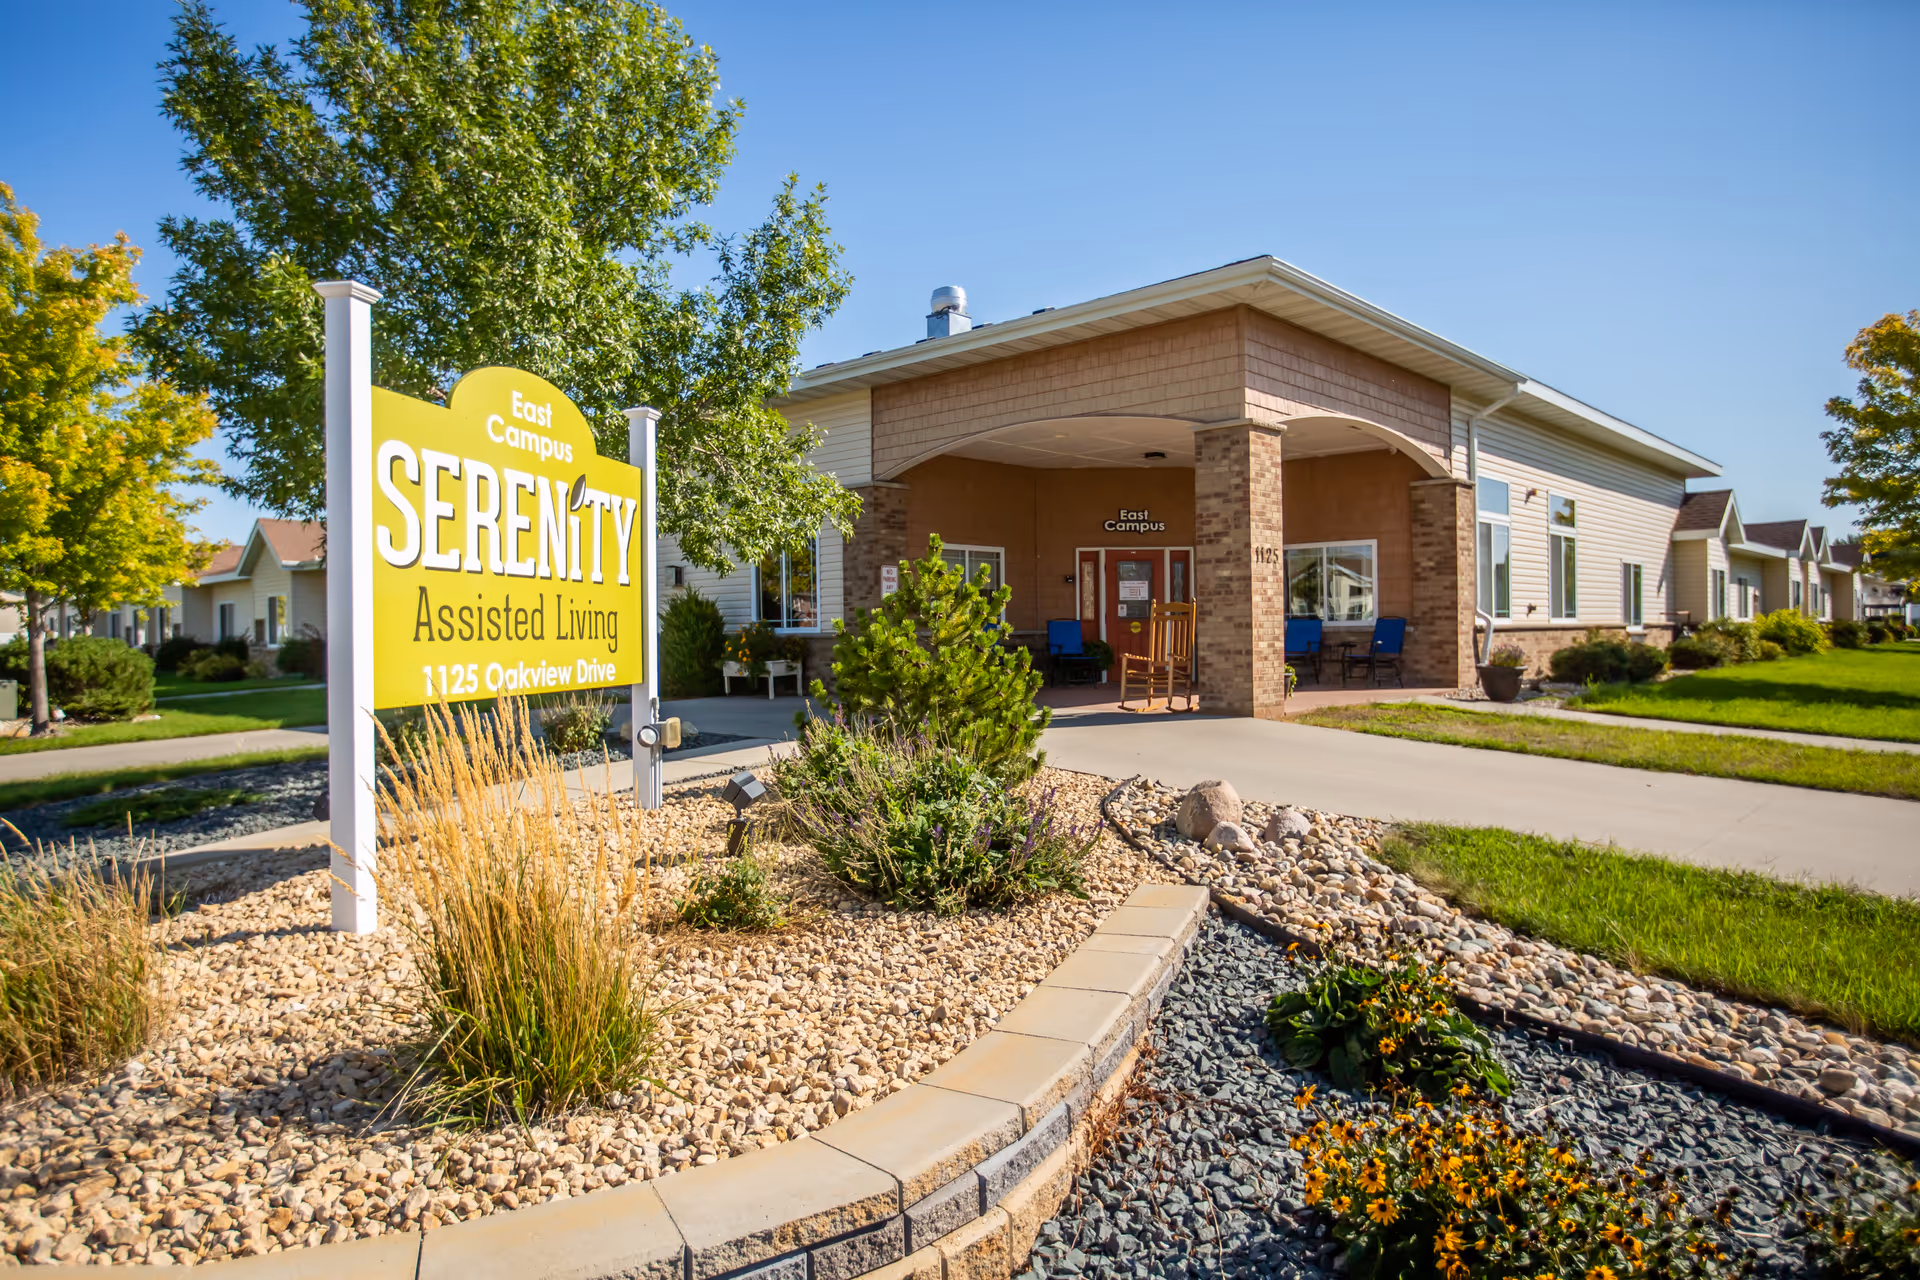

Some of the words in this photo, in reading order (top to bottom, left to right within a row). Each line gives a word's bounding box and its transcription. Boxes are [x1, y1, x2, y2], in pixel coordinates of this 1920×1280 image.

[511, 390, 552, 428] East
[487, 414, 573, 463] Campus
[1104, 520, 1165, 533] Campus
[1119, 509, 1149, 520] East
[1255, 546, 1279, 564] 1125
[413, 585, 545, 642] Assisted
[556, 594, 618, 653] Living
[423, 663, 479, 697] 1125
[485, 660, 572, 693] Oakview
[576, 657, 616, 684] Drive
